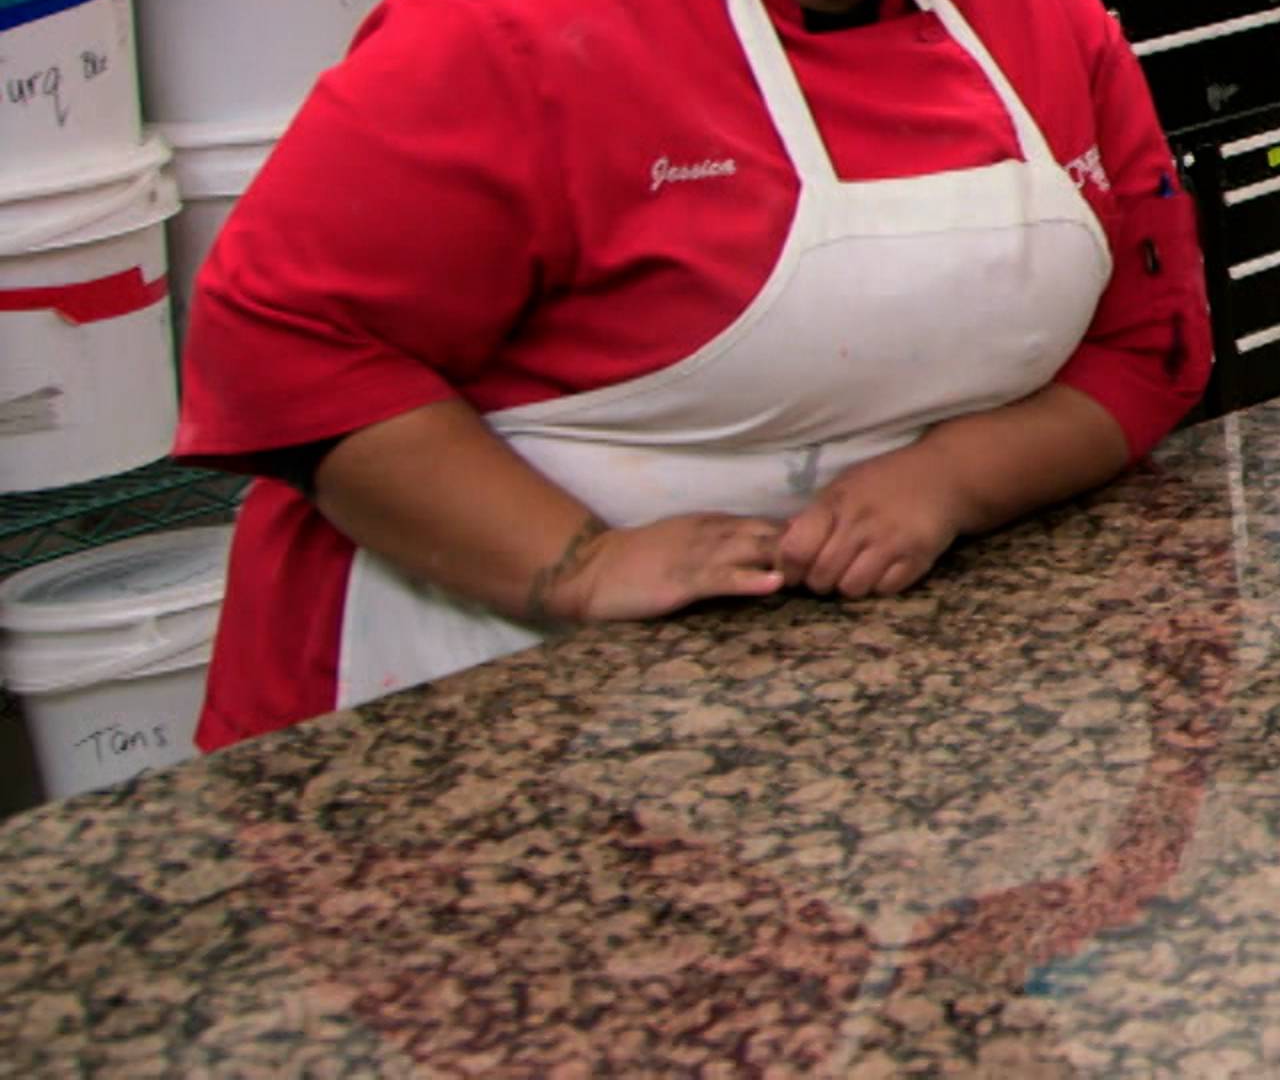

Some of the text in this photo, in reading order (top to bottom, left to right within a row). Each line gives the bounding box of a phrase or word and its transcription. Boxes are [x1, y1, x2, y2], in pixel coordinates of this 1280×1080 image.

[0, 60, 70, 126] urq
[650, 156, 736, 191] Jessica
[73, 724, 168, 763] Tans
